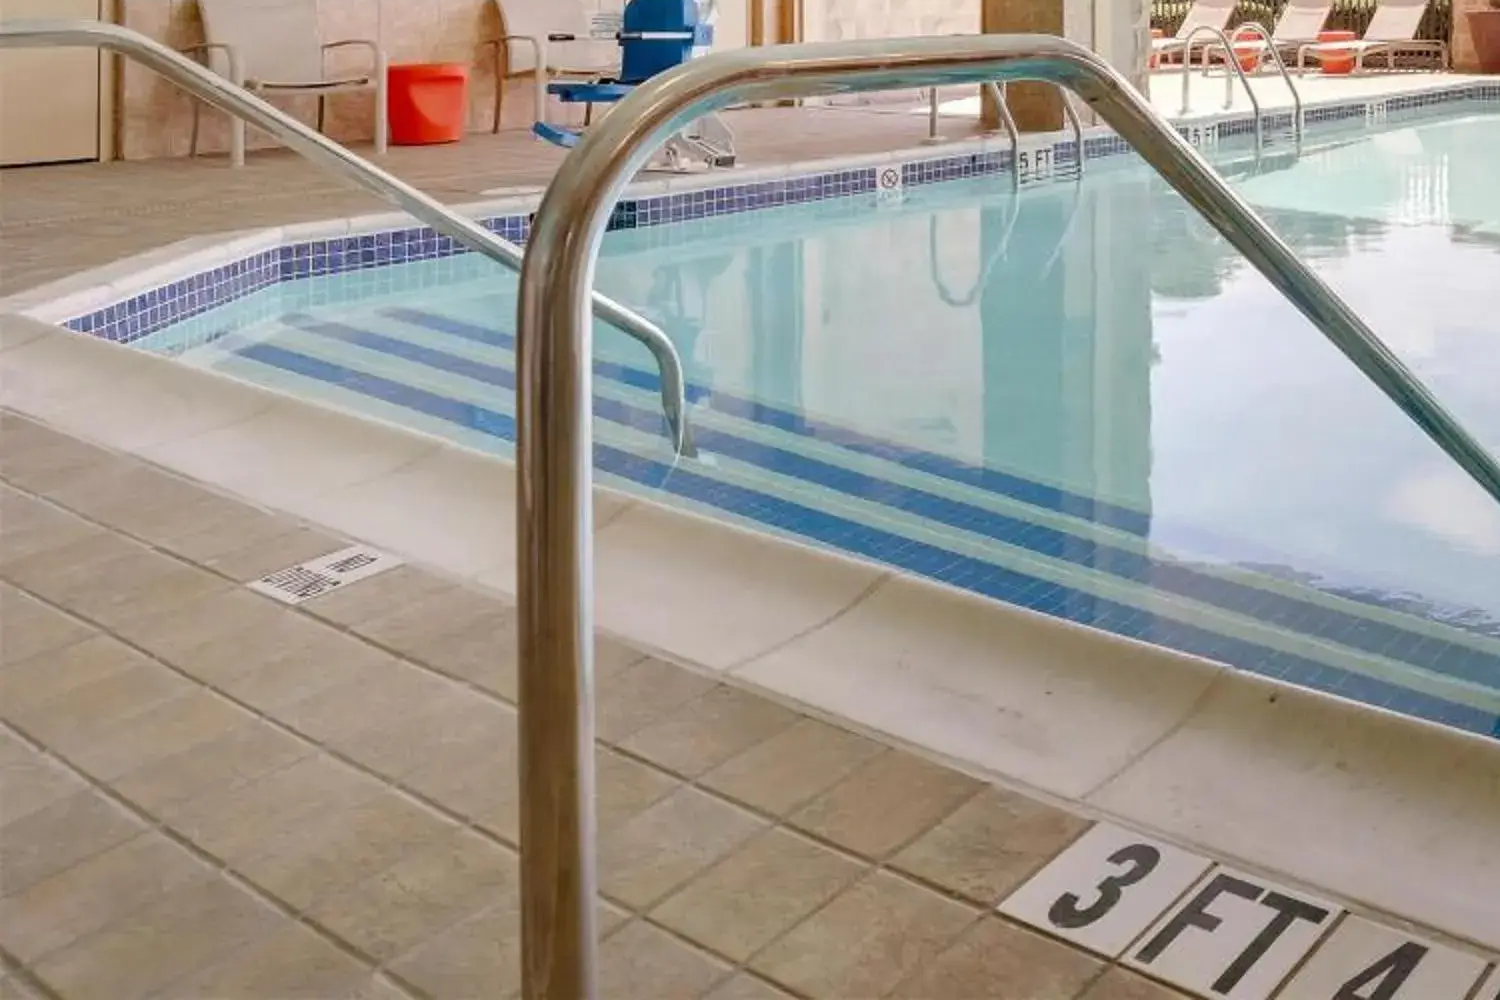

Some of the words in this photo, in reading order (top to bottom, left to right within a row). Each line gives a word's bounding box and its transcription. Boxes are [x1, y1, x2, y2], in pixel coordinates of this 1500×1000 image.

[1019, 151, 1029, 168] 5
[1035, 149, 1051, 167] FT
[1047, 843, 1161, 929] 3
[1133, 872, 1330, 995] FT
